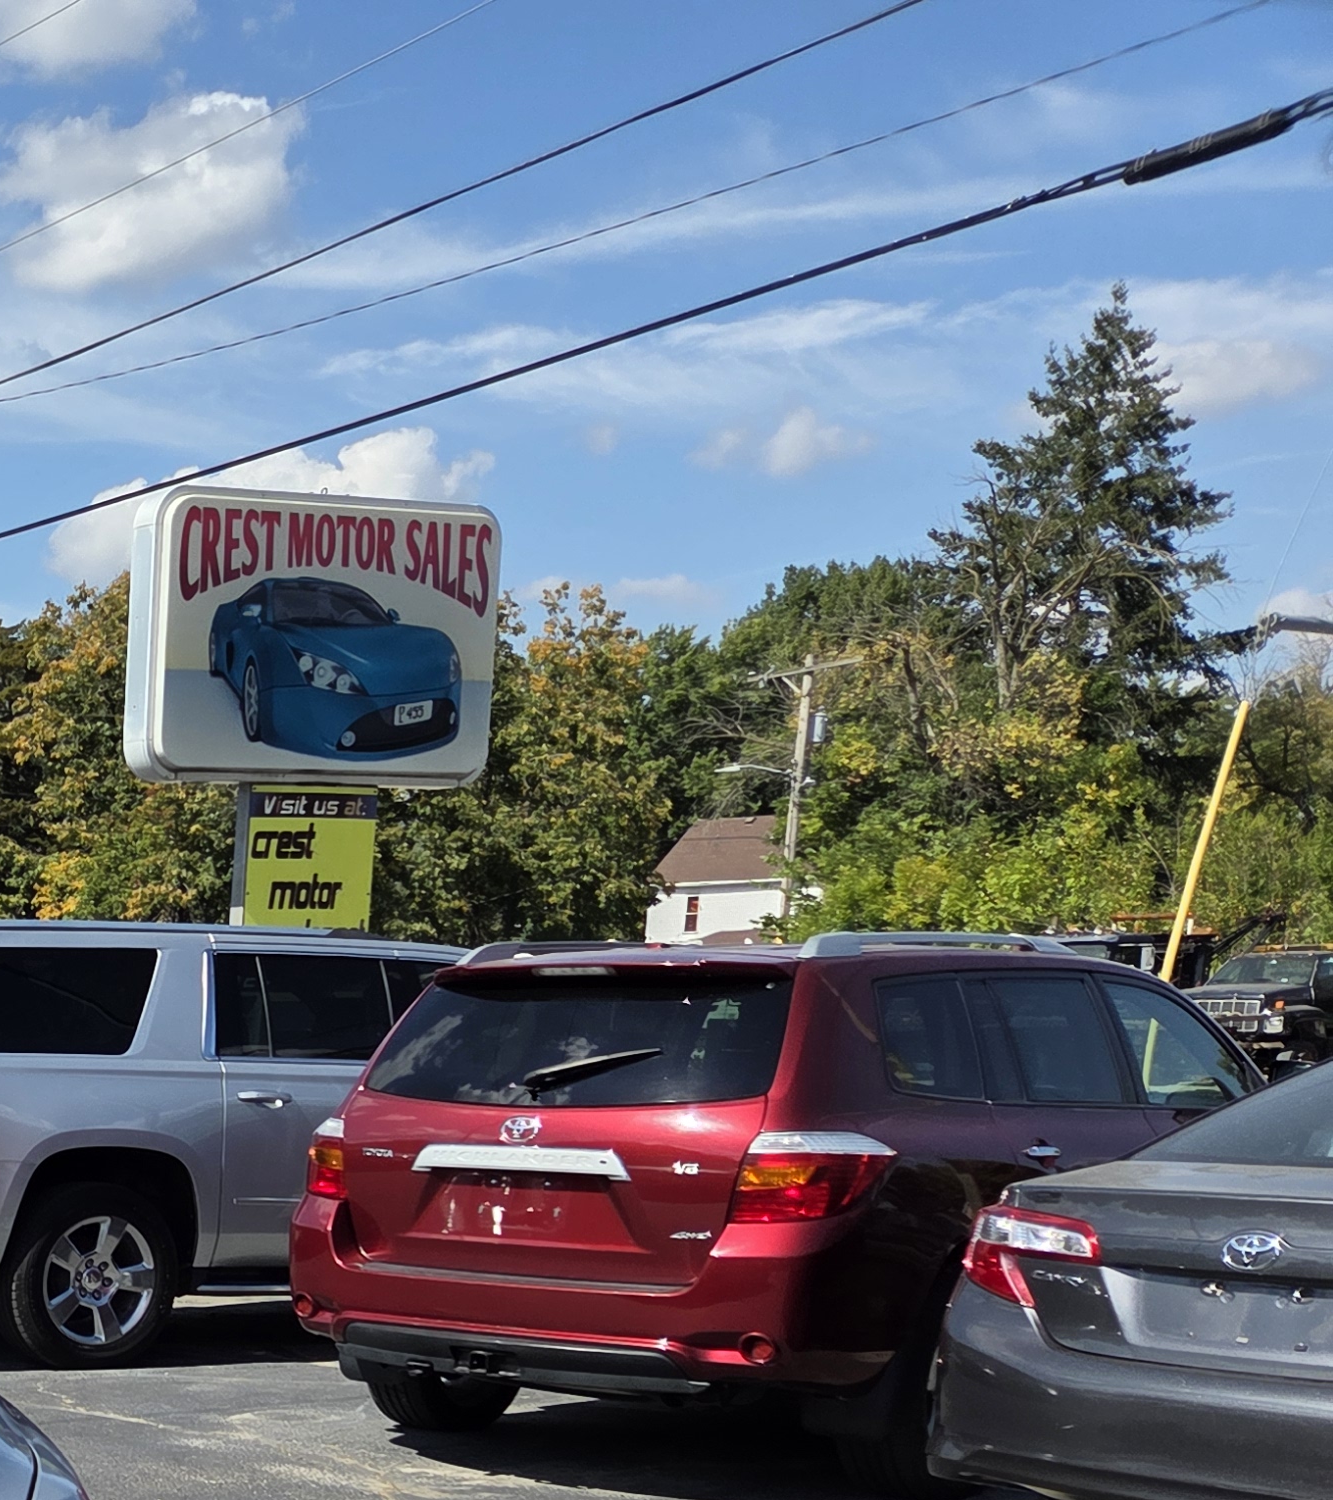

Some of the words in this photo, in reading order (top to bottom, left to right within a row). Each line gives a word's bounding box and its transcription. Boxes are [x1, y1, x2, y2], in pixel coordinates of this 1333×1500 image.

[179, 505, 282, 601] CREST
[287, 512, 396, 575] MOTOR
[404, 519, 493, 618] SALES
[263, 795, 307, 815] Visit
[313, 800, 340, 815] us
[344, 797, 367, 816] at:
[251, 822, 316, 859] crest
[268, 873, 342, 910] motor
[432, 1149, 595, 1168] HIGHLANDER
